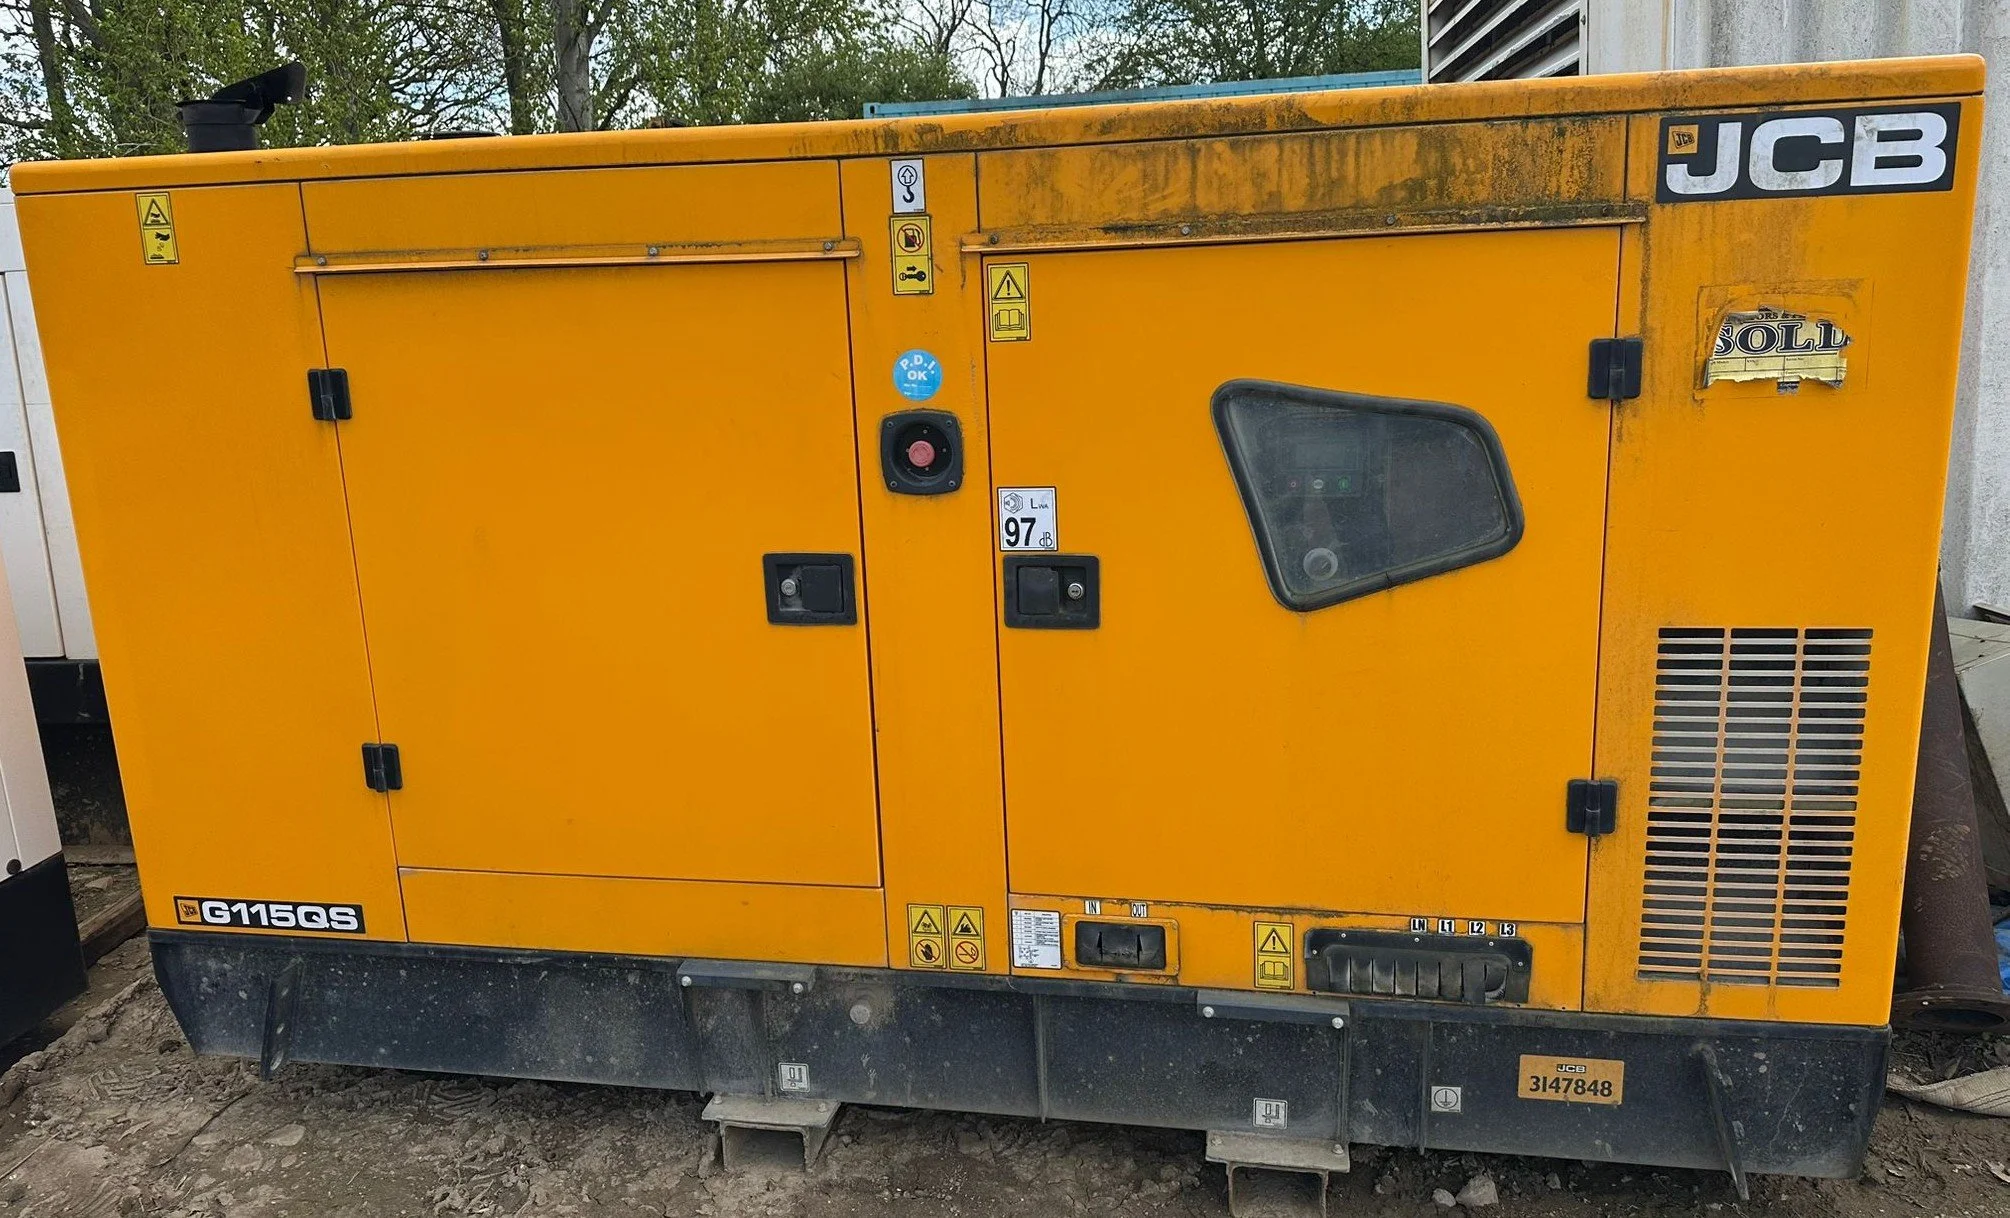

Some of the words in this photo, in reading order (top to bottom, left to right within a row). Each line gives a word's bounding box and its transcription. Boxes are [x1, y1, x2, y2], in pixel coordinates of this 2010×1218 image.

[1675, 132, 1694, 147] JCB
[1666, 112, 1948, 195] JCB
[907, 370, 928, 381] OK
[1004, 516, 1037, 547] 97
[182, 904, 198, 917] JCB
[1088, 900, 1097, 914] IN
[1132, 903, 1146, 917] OUT
[201, 900, 359, 931] G115QS
[1412, 918, 1426, 931] LN
[1440, 920, 1453, 932] L1
[1470, 922, 1484, 934] L2
[1500, 923, 1515, 936] L3
[1557, 1064, 1586, 1073] JCB
[1529, 1075, 1613, 1098] 3147848
